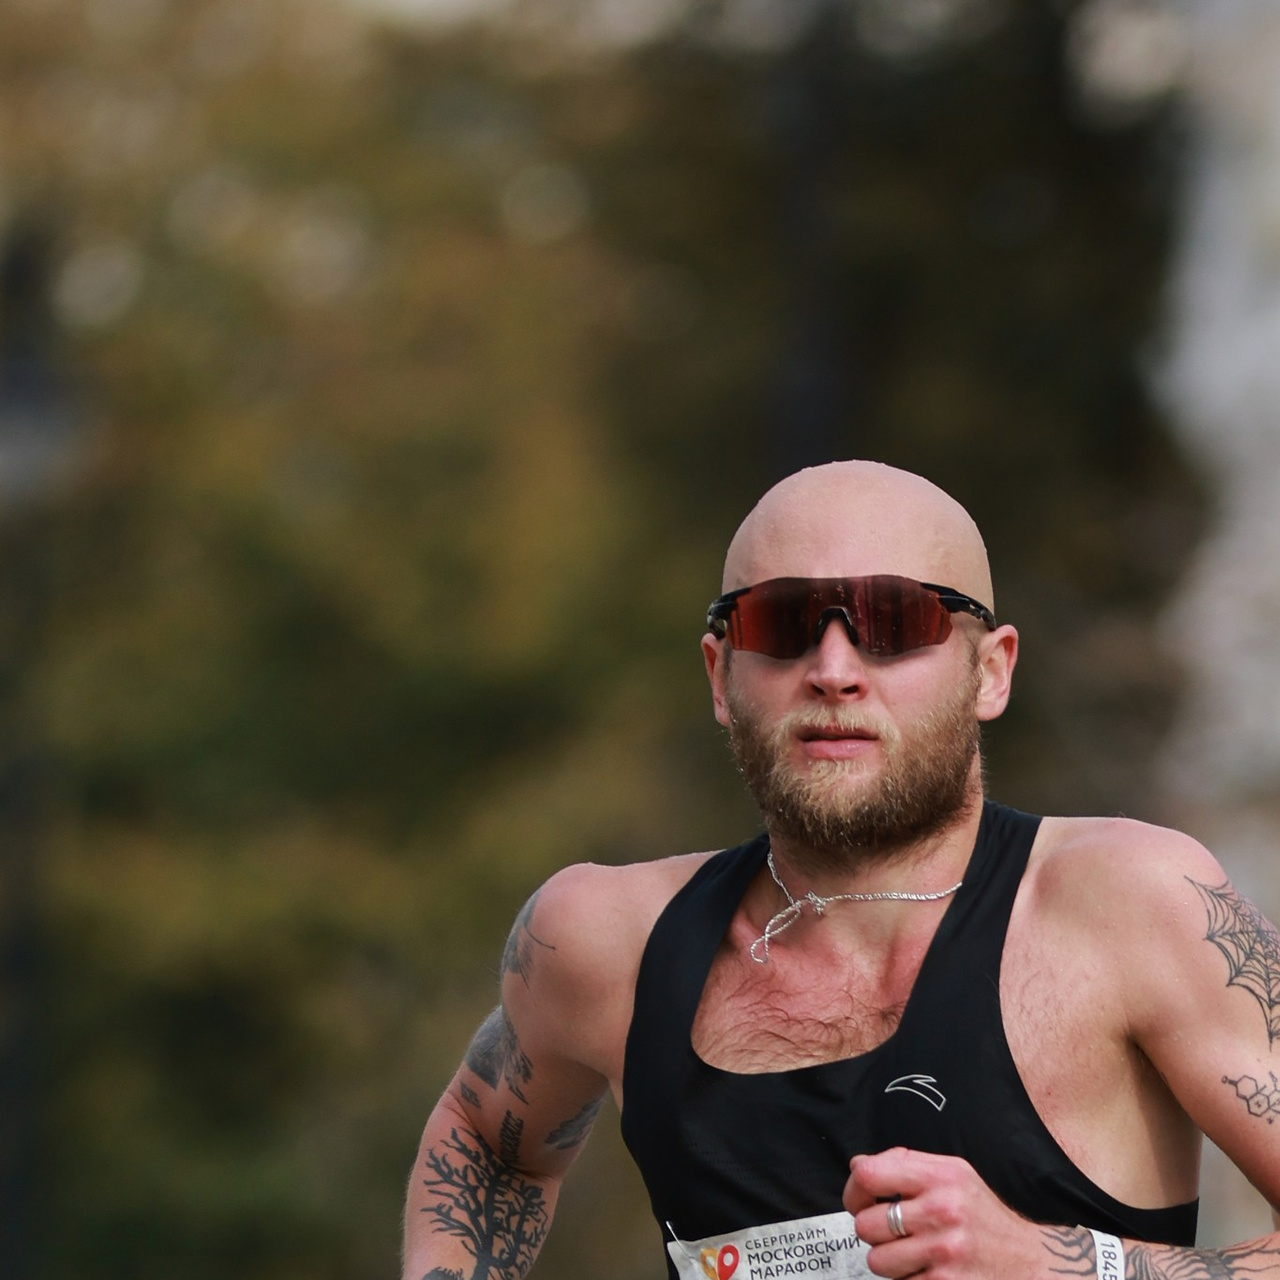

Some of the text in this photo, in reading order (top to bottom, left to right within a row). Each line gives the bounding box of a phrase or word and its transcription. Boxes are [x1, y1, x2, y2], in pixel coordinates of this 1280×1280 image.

[745, 1228, 826, 1250] СБЕРПРАЙМ
[747, 1234, 860, 1265] МОСКОВСКИЙ
[750, 1256, 832, 1280] МАРАФОН
